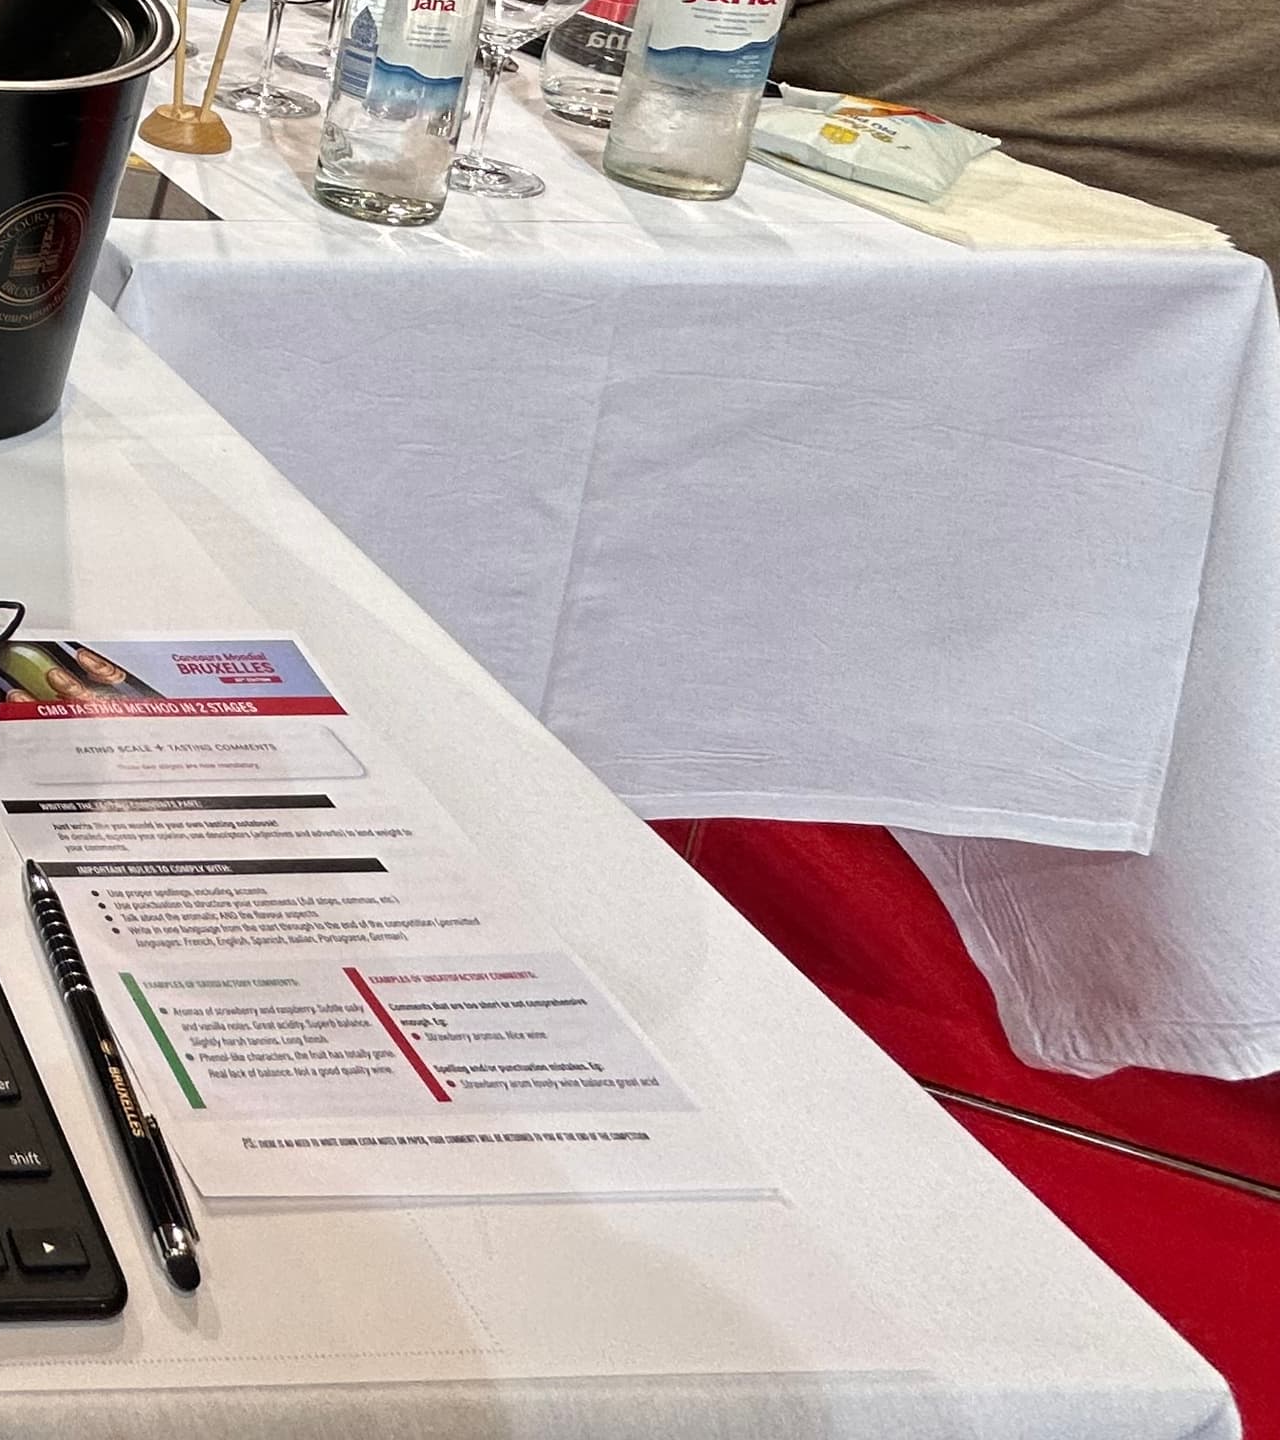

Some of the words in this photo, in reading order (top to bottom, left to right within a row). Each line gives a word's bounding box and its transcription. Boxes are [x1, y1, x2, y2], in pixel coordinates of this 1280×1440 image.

[171, 653, 222, 662] Concours
[176, 662, 275, 675] BRUXELLES
[68, 703, 123, 716] TASTING
[127, 702, 179, 715] METHOD
[181, 702, 194, 714] IN
[197, 702, 207, 714] 2
[207, 701, 258, 714] STAGES
[108, 1065, 145, 1139] BRUXELLES
[9, 1151, 41, 1165] shift
